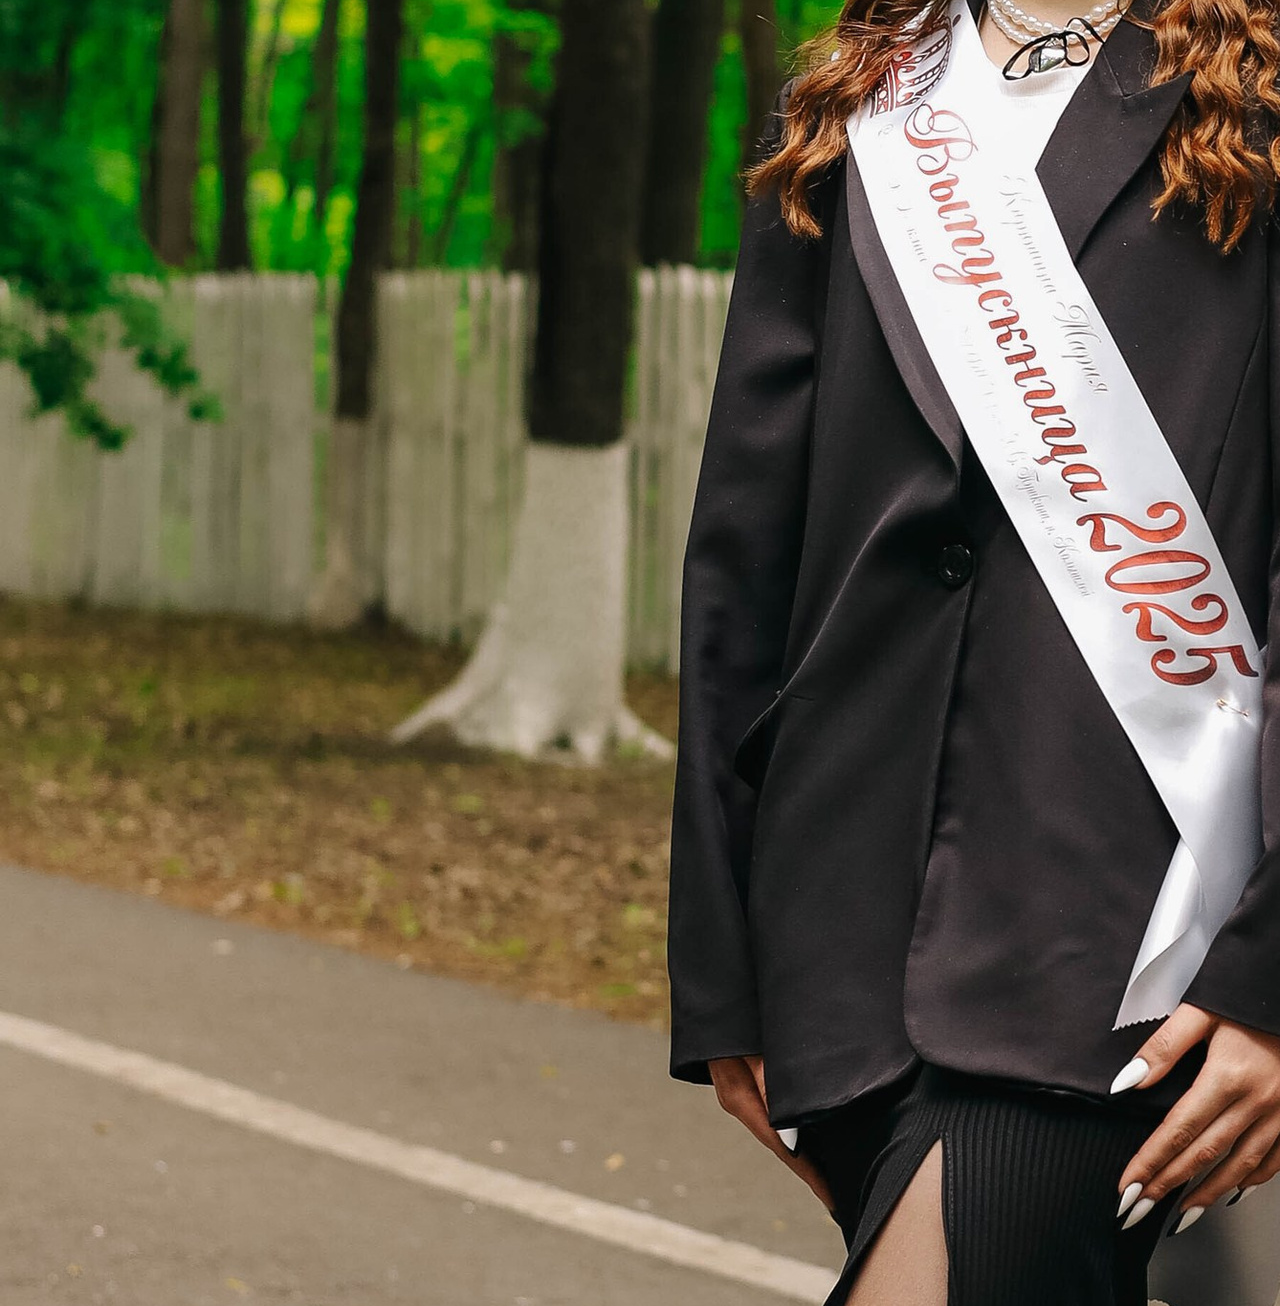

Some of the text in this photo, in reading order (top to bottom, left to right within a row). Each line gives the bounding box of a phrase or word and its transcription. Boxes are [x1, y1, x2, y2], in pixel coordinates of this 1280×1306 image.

[903, 99, 1259, 686] Выпускница 2025
[1052, 300, 1109, 393] Мария
